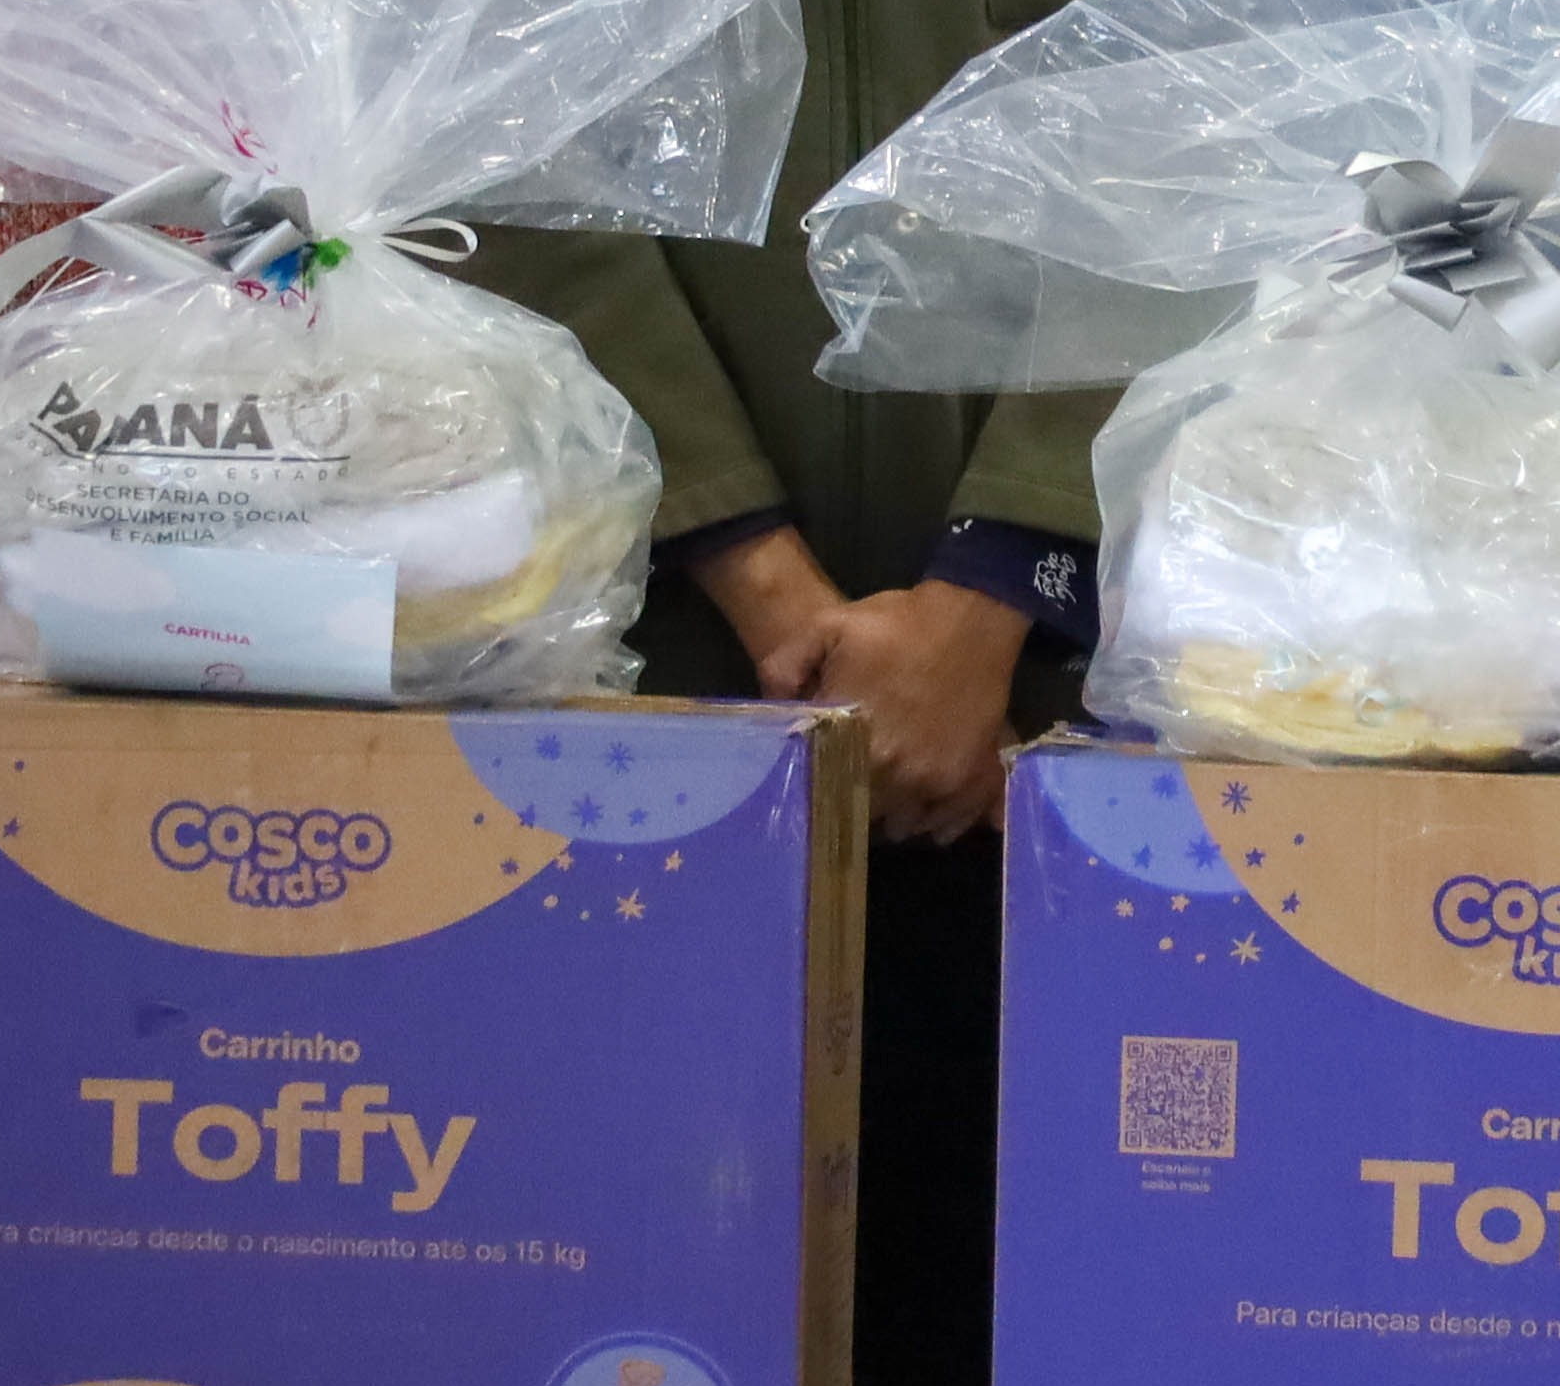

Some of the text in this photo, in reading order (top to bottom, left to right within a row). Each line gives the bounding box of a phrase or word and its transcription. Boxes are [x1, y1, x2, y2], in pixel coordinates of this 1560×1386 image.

[25, 486, 311, 525] DESENVOLVIMENTO SOCIAL
[77, 483, 250, 506] SECRETARIA DO
[111, 527, 215, 545] E FAMÍLIA
[163, 621, 250, 645] CARTILHA
[229, 859, 346, 908] kids
[198, 1027, 362, 1065] Carrinho
[79, 1076, 476, 1213] Toffy
[28, 1223, 139, 1250] crianças
[147, 1227, 228, 1253] desde
[238, 1234, 254, 1253] o
[263, 1232, 416, 1259] nascimento
[424, 1237, 466, 1261] até
[475, 1243, 507, 1263] os
[518, 1240, 544, 1264] 15
[554, 1242, 587, 1271] kg
[1237, 1301, 1297, 1327] Para
[1306, 1305, 1420, 1335] crianças
[1428, 1310, 1511, 1337] desde
[1520, 1318, 1538, 1337] o
